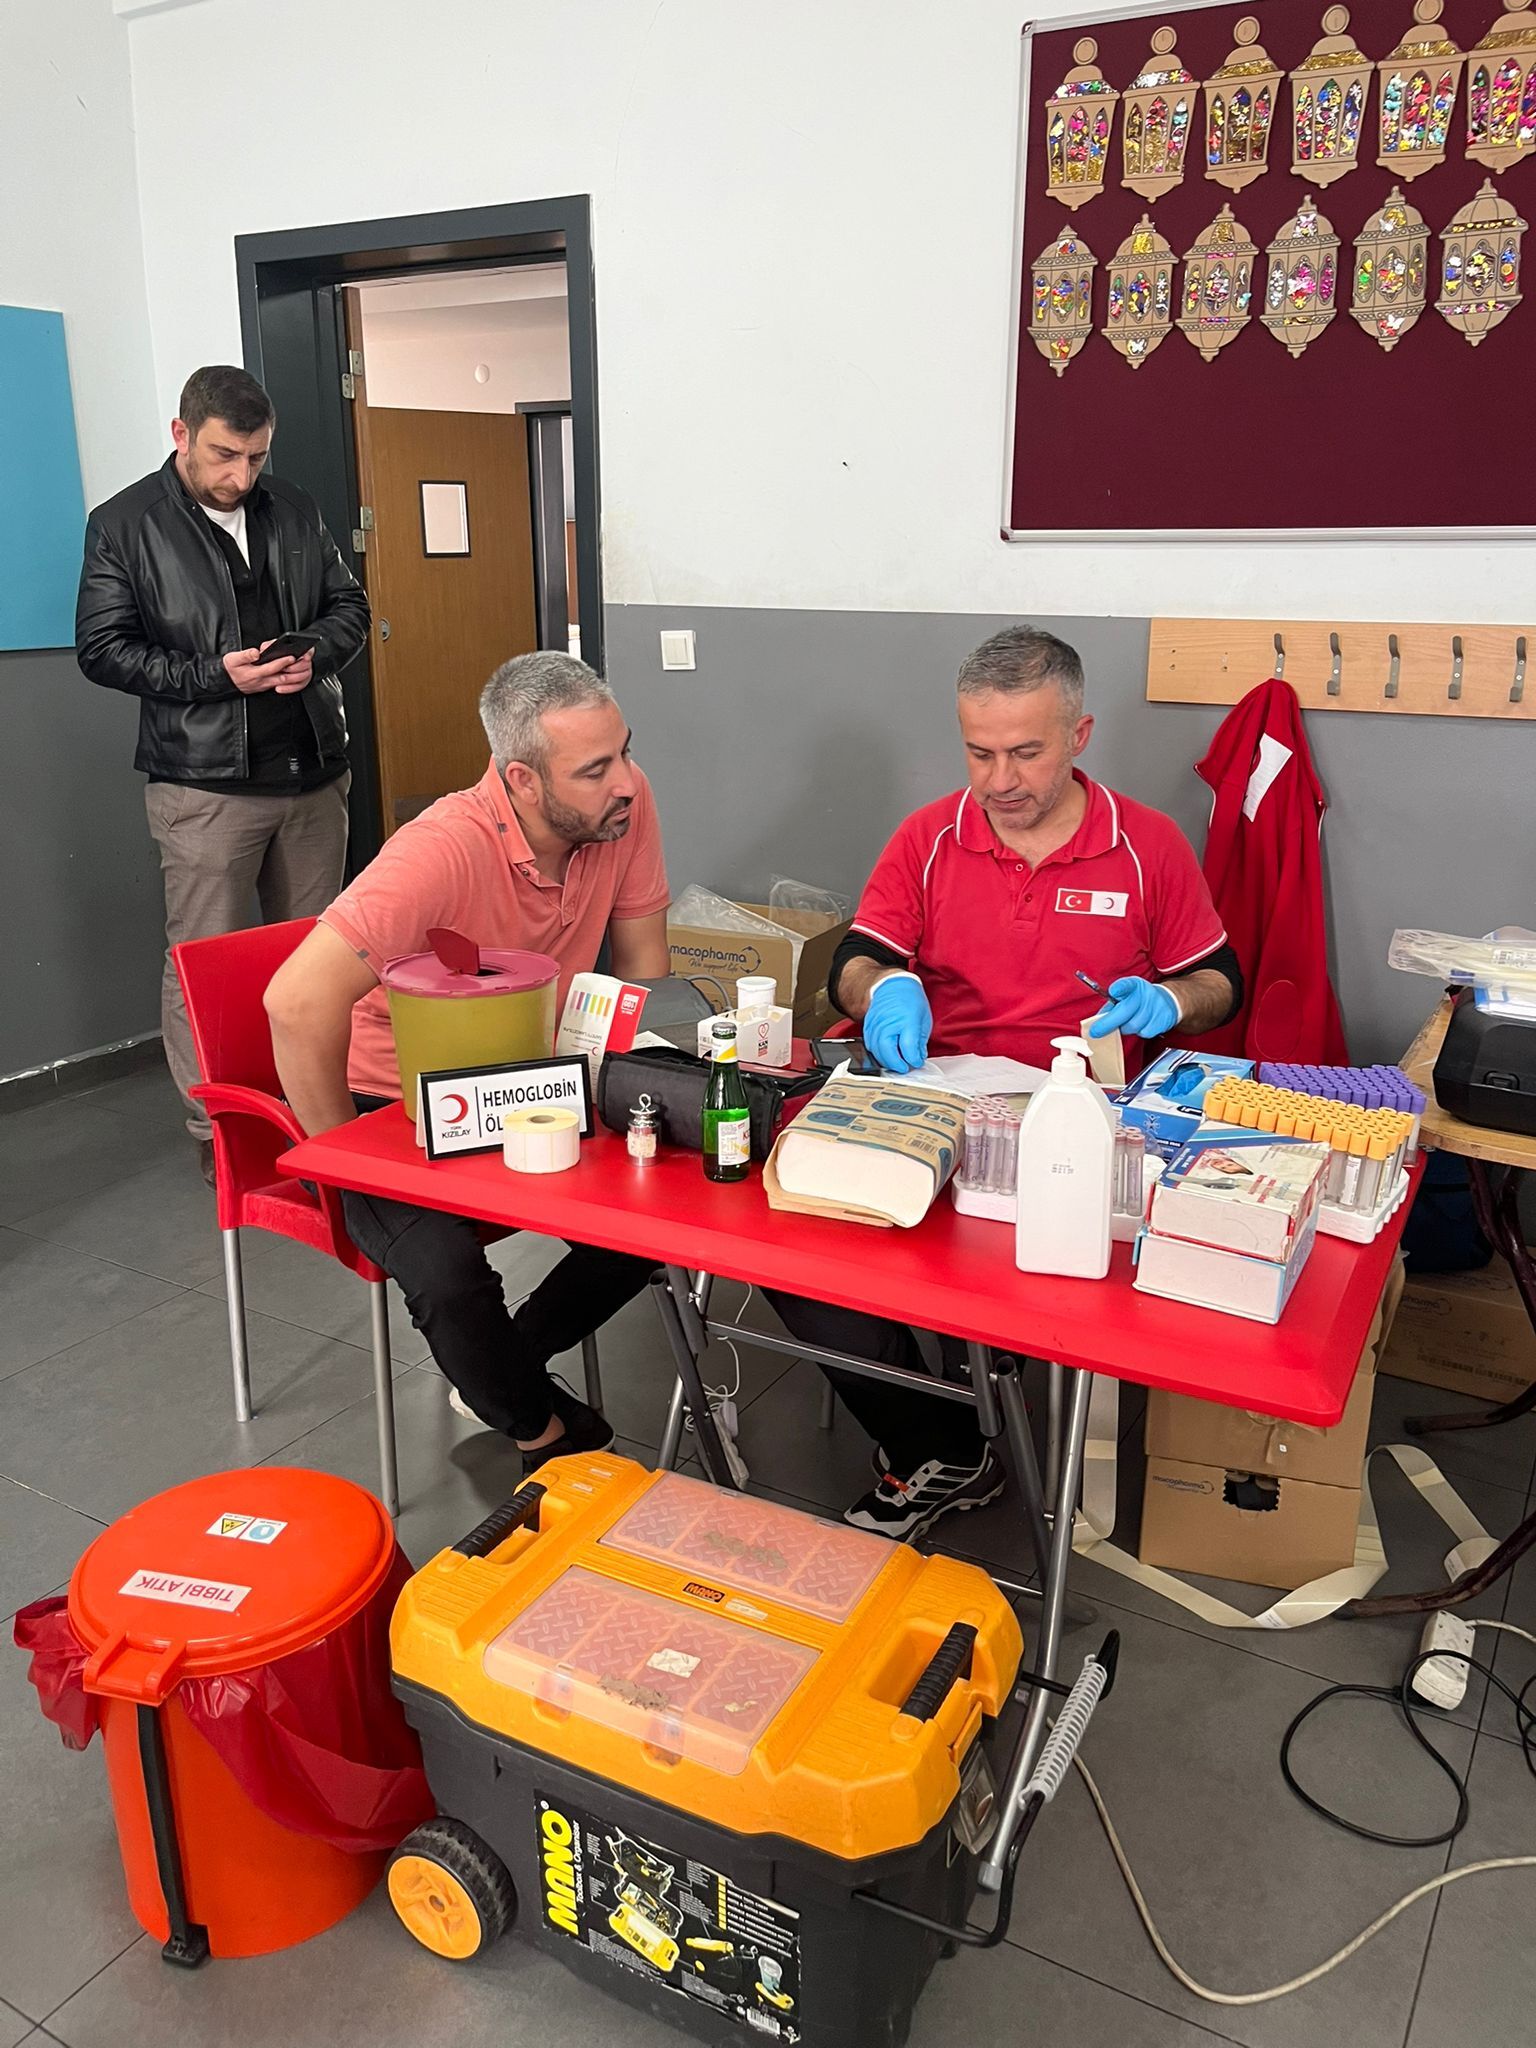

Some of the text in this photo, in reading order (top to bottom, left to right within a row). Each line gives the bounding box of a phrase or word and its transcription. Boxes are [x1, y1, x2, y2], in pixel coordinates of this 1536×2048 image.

[669, 944, 747, 963] macopharma
[483, 1078, 577, 1108] HEMOGLOBİN
[441, 1128, 471, 1140] KIZILAY
[134, 1575, 235, 1603] TIBBİ ATIK
[686, 1583, 722, 1600] MANO
[572, 1819, 583, 1862] Organiser
[541, 1809, 579, 1936] MANO
[574, 1872, 584, 1904] Toolbox
